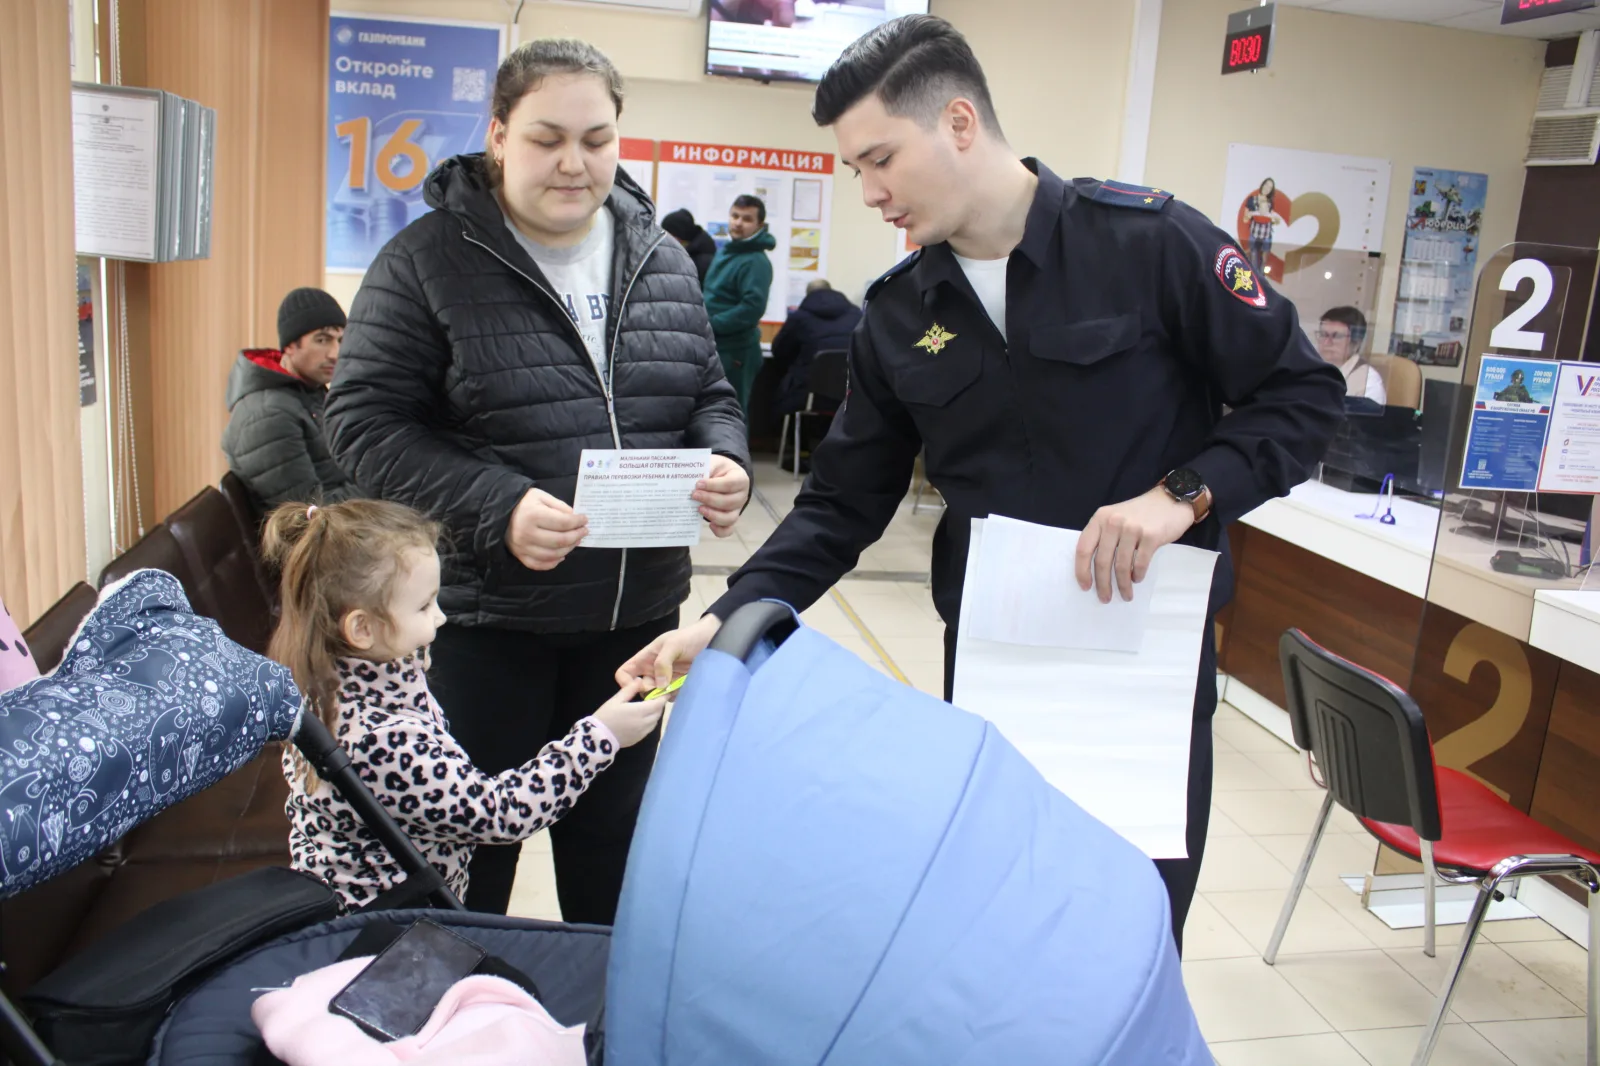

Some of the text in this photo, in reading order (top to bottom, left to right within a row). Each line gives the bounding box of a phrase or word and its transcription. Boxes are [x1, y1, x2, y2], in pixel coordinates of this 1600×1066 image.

[1246, 14, 1252, 26] 1
[358, 32, 426, 47] ГАЗПРОМБАНК
[335, 56, 434, 79] Откройте
[335, 80, 396, 100] вклад
[673, 145, 824, 170] ИНФОРМАЦИЯ
[1489, 258, 1554, 351] 2
[1433, 622, 1533, 803] 2
